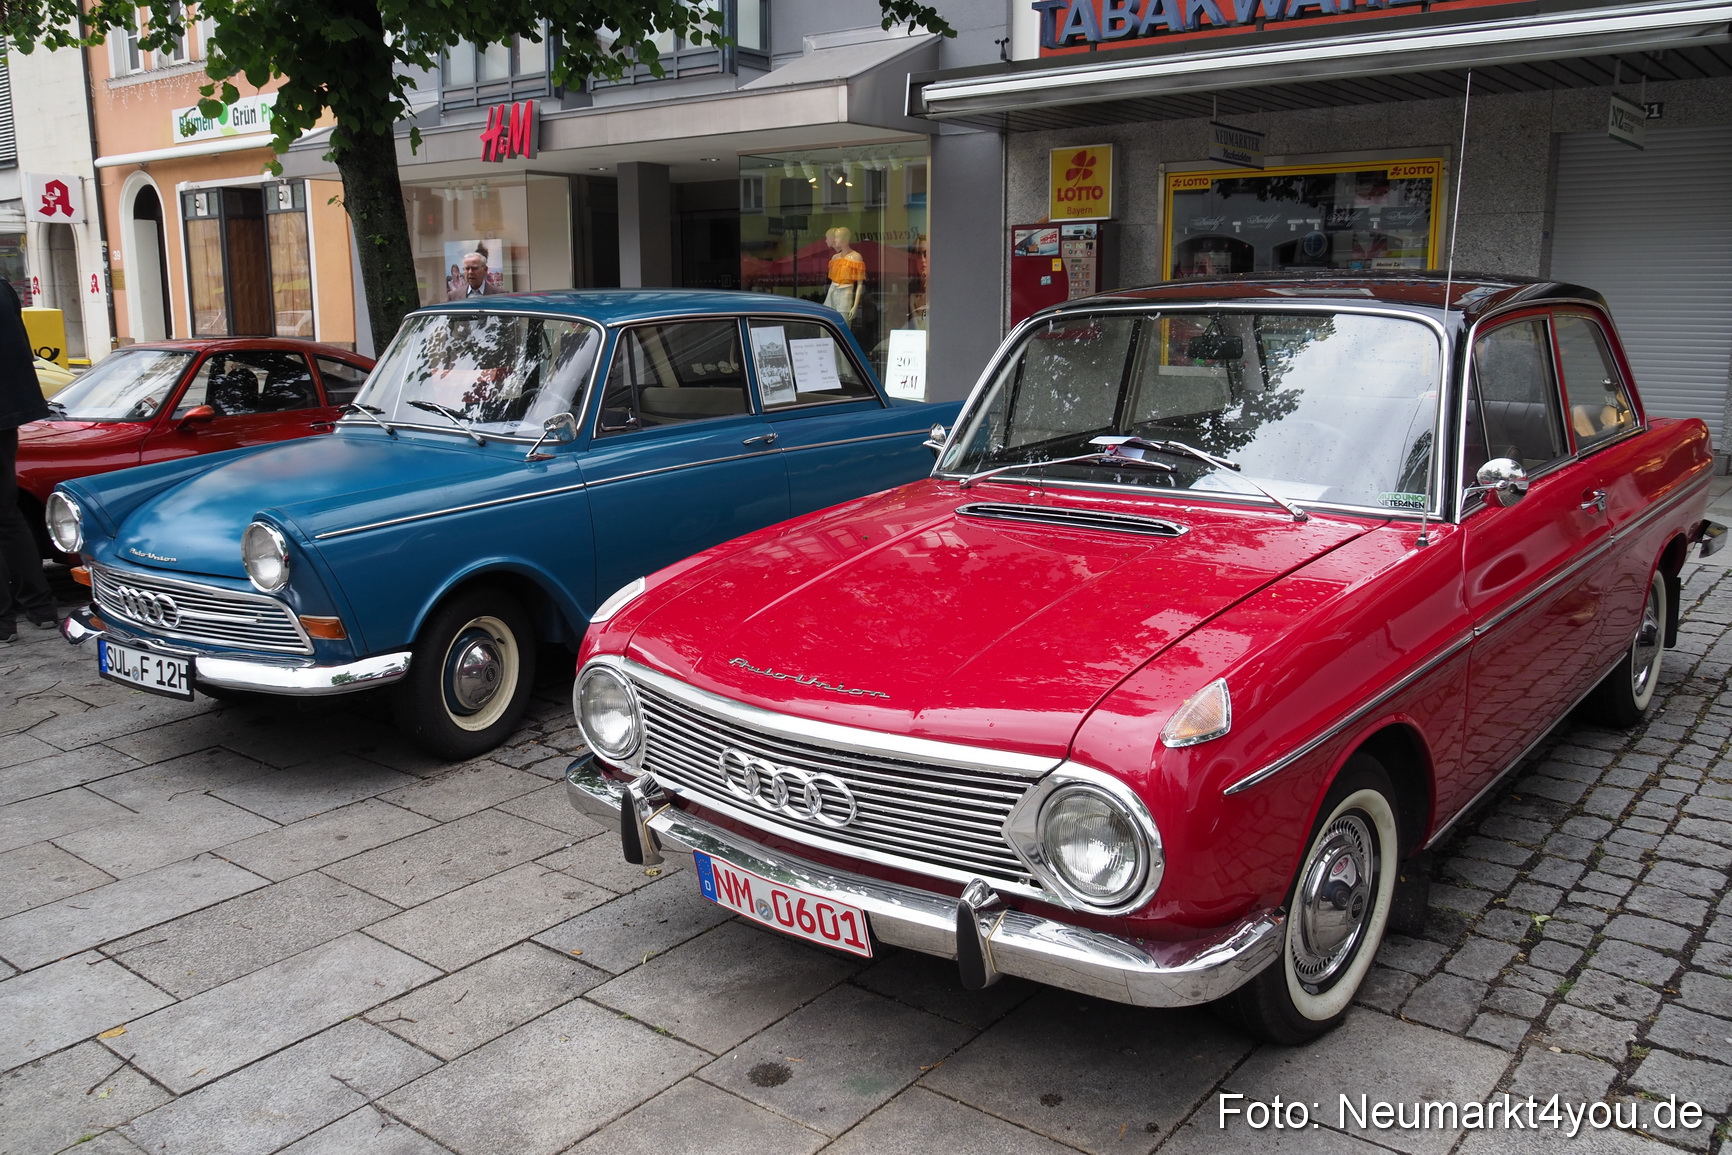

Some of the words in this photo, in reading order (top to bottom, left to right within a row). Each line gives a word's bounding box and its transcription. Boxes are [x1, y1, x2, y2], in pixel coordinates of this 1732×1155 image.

[1031, 0, 1425, 48] TABAKW
[232, 104, 257, 127] Grün
[480, 99, 533, 163] H&M
[1215, 128, 1260, 152] NEUMARKTER
[1182, 177, 1210, 187] LOTTO
[1402, 165, 1434, 176] LOTTO
[1056, 185, 1104, 202] LOTTO
[1066, 206, 1093, 217] Bayern
[113, 250, 122, 261] 39
[107, 645, 131, 677] SUL
[140, 655, 150, 682] F
[156, 660, 190, 690] 12H
[704, 879, 712, 892] D
[712, 863, 755, 915] NM
[771, 889, 866, 950] 0601
